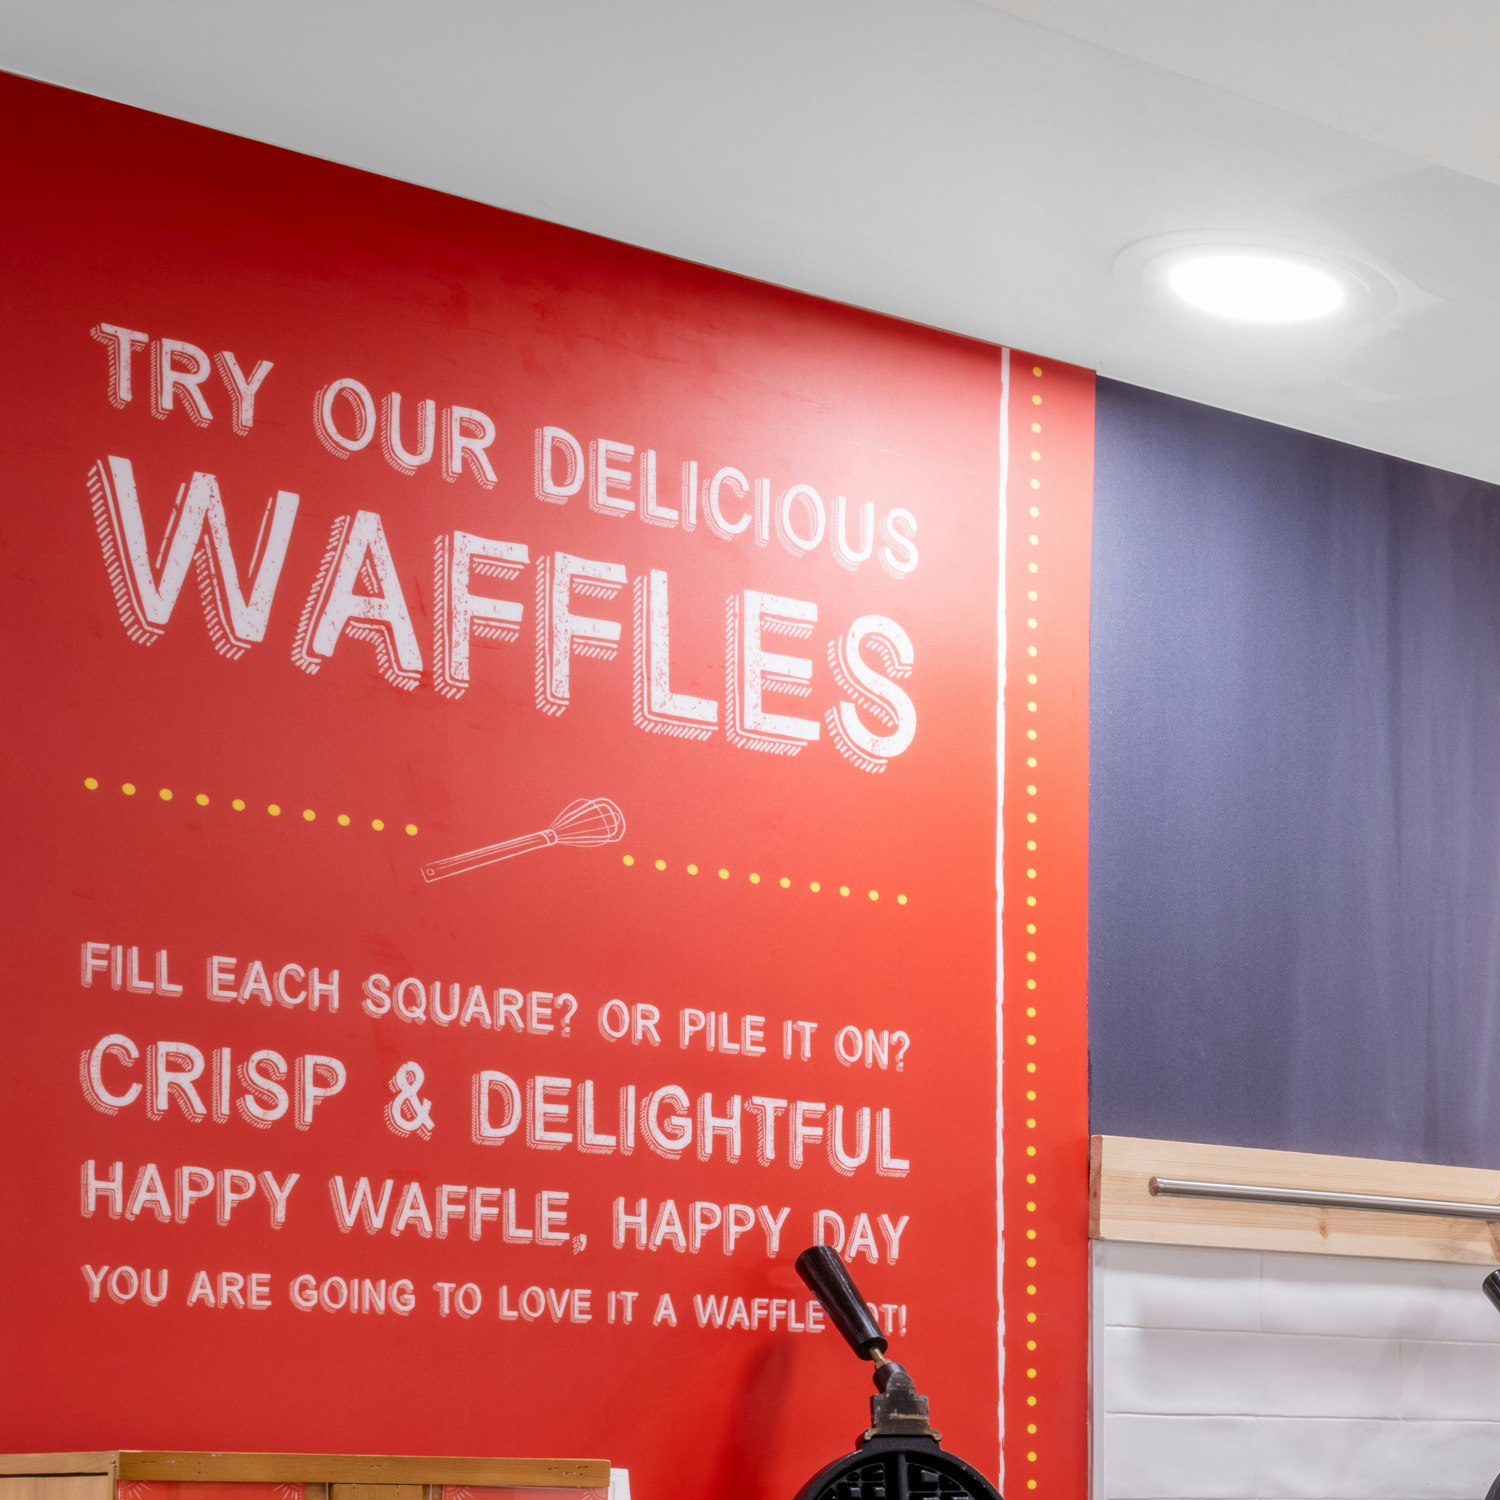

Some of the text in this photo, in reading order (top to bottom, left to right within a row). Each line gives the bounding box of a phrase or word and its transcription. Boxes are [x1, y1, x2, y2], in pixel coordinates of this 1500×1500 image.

[90, 321, 920, 579] TRY OUR DELICIOUS
[87, 455, 918, 774] WAFFLES
[81, 940, 911, 1073] FILL EACH SQUARE? OR PILE IT ON?
[79, 1033, 911, 1178] CRISP & DELIGHTFUL
[80, 1158, 911, 1265] HAPPY WAFFLE, HAPPY DAY
[81, 1262, 907, 1337] YOU ARE GOING TO LOVE IT A WAFFLE T!
